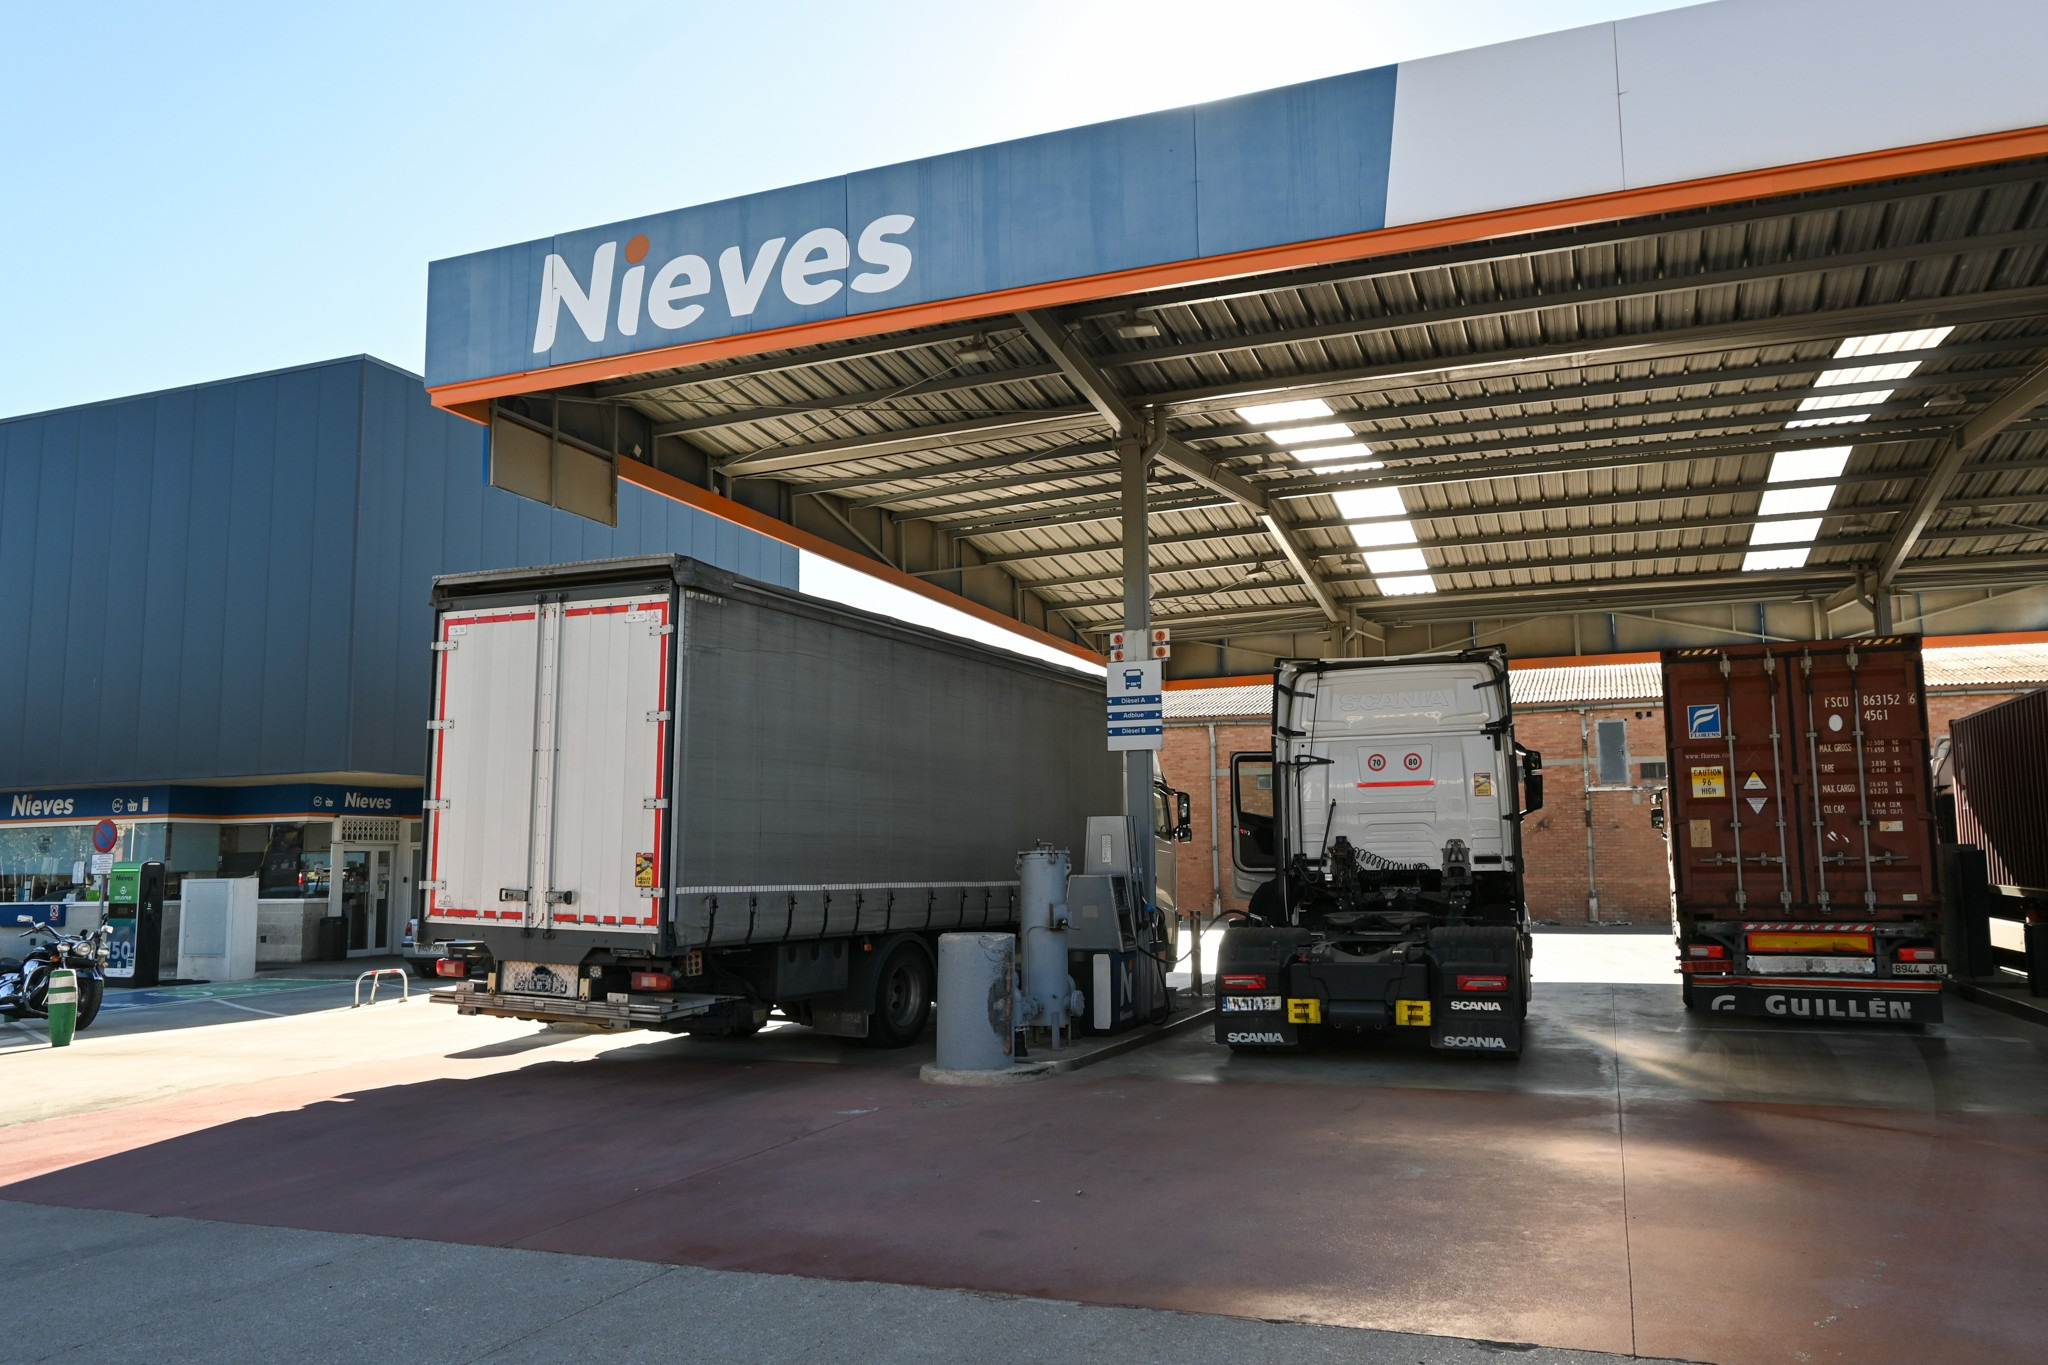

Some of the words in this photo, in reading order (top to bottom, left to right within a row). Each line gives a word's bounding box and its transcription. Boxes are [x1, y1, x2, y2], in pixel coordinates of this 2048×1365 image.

[532, 214, 916, 354] Nieves
[1339, 688, 1449, 712] SCANIA
[1824, 696, 1849, 709] FSCU
[1863, 694, 1900, 706] 863152
[1909, 693, 1916, 704] 6
[1864, 709, 1888, 721] 45G1
[1834, 743, 1852, 753] GROSS
[1685, 752, 1730, 760] www.florens.co
[1372, 758, 1382, 767] 70
[1408, 758, 1418, 766] 80
[1693, 768, 1722, 777] CAUTION
[1820, 764, 1835, 773] TARE
[1701, 787, 1717, 796] HIGH
[1836, 784, 1856, 793] CARGO
[11, 794, 74, 817] Nieves
[344, 791, 392, 809] Nieves
[106, 940, 131, 960] 150
[1895, 964, 1920, 973] 8944
[1925, 964, 1944, 974] JGJ
[1450, 1001, 1502, 1012] SCANIA
[1227, 1032, 1284, 1043] SCANIA
[1443, 1036, 1506, 1049] SCANIA
